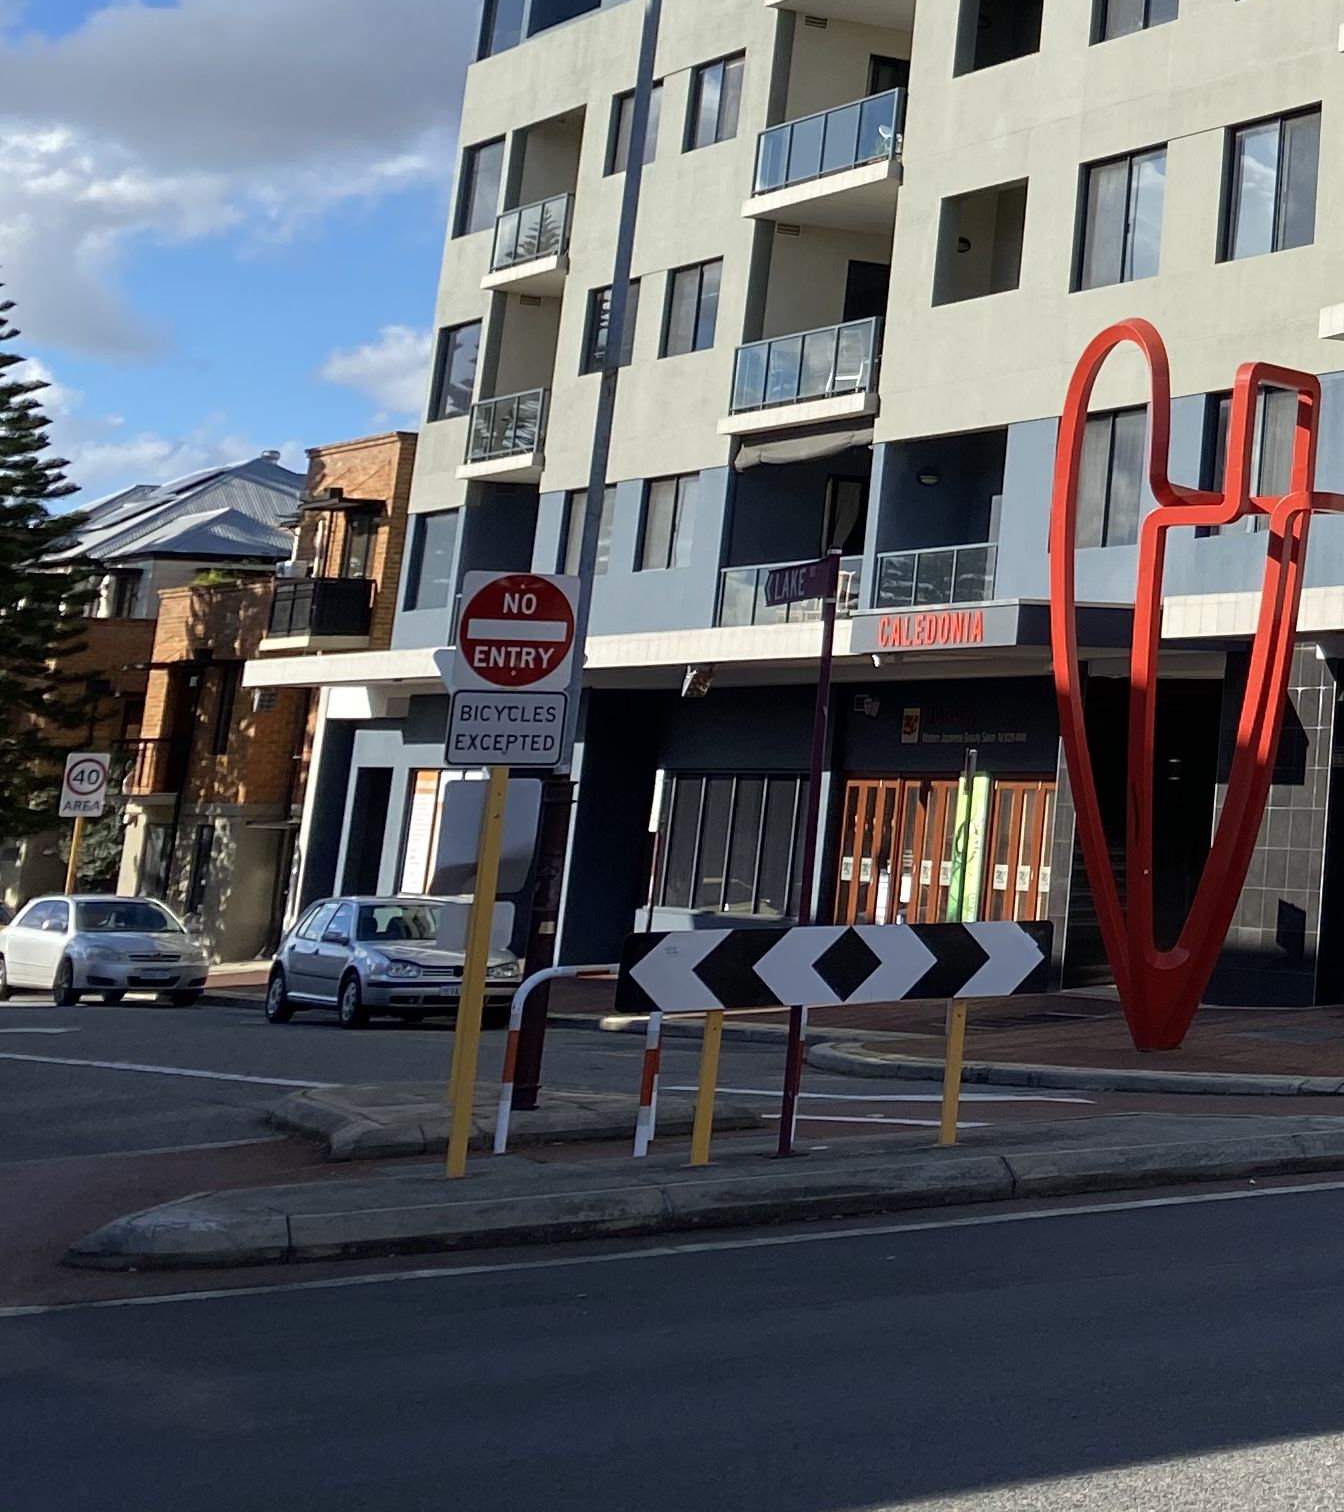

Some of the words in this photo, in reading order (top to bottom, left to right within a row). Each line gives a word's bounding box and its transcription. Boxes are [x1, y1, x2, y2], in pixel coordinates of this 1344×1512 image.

[774, 568, 805, 601] LAKE
[503, 593, 537, 615] NO
[878, 611, 985, 648] CALEDONIA
[473, 646, 555, 669] ENTRY
[459, 705, 557, 723] BICYCLES
[454, 734, 555, 752] EXCEPTED
[72, 769, 100, 785] 40
[62, 800, 101, 811] AREA
